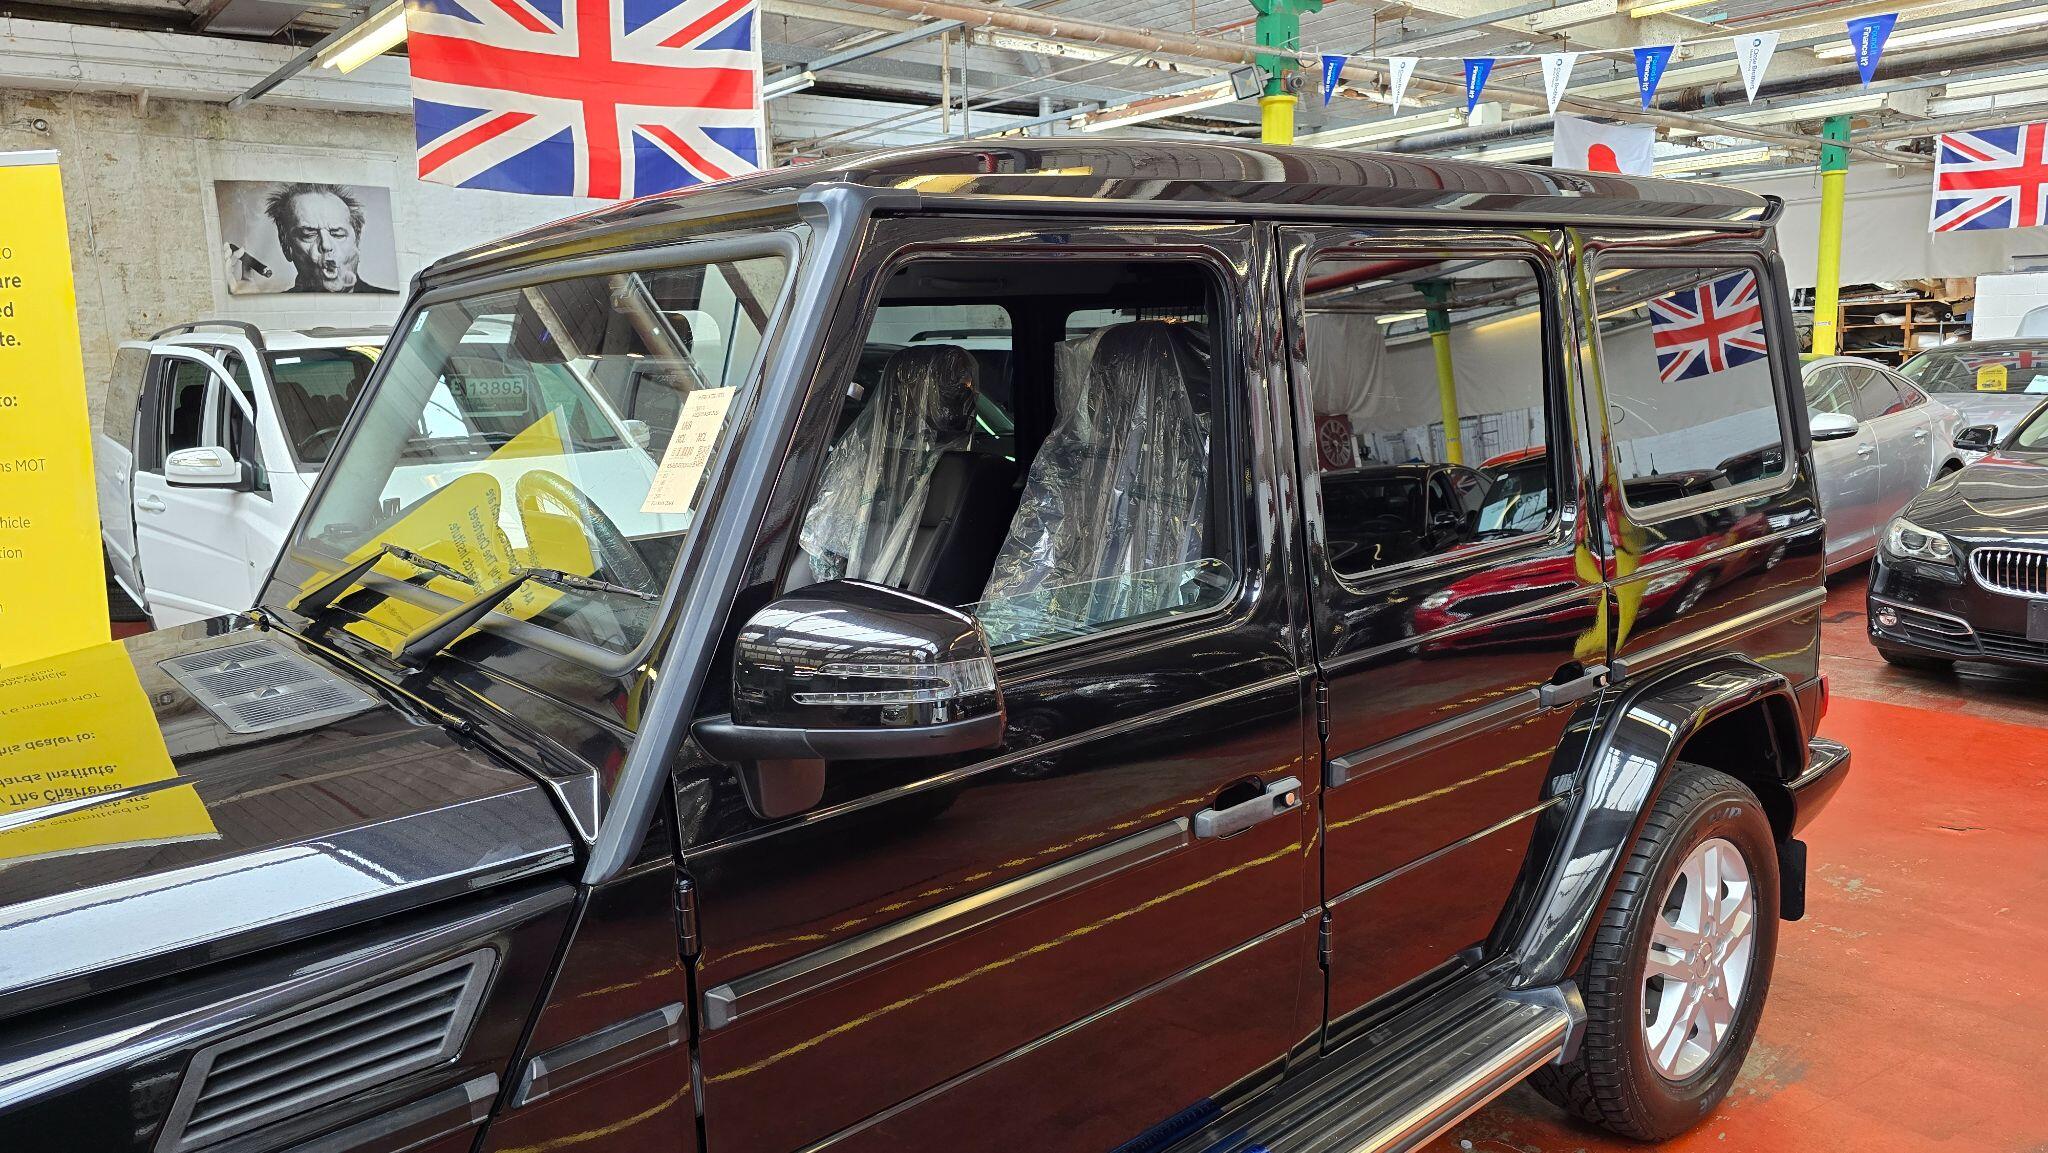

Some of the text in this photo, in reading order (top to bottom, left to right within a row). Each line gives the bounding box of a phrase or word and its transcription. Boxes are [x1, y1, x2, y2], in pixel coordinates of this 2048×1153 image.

[1860, 26, 1872, 66] Finance it?
[1871, 25, 1880, 50] Found
[1641, 56, 1652, 92] Finance it?
[1652, 55, 1660, 76] Found
[1749, 65, 1758, 90] Brothers
[15, 459, 46, 472] MOT
